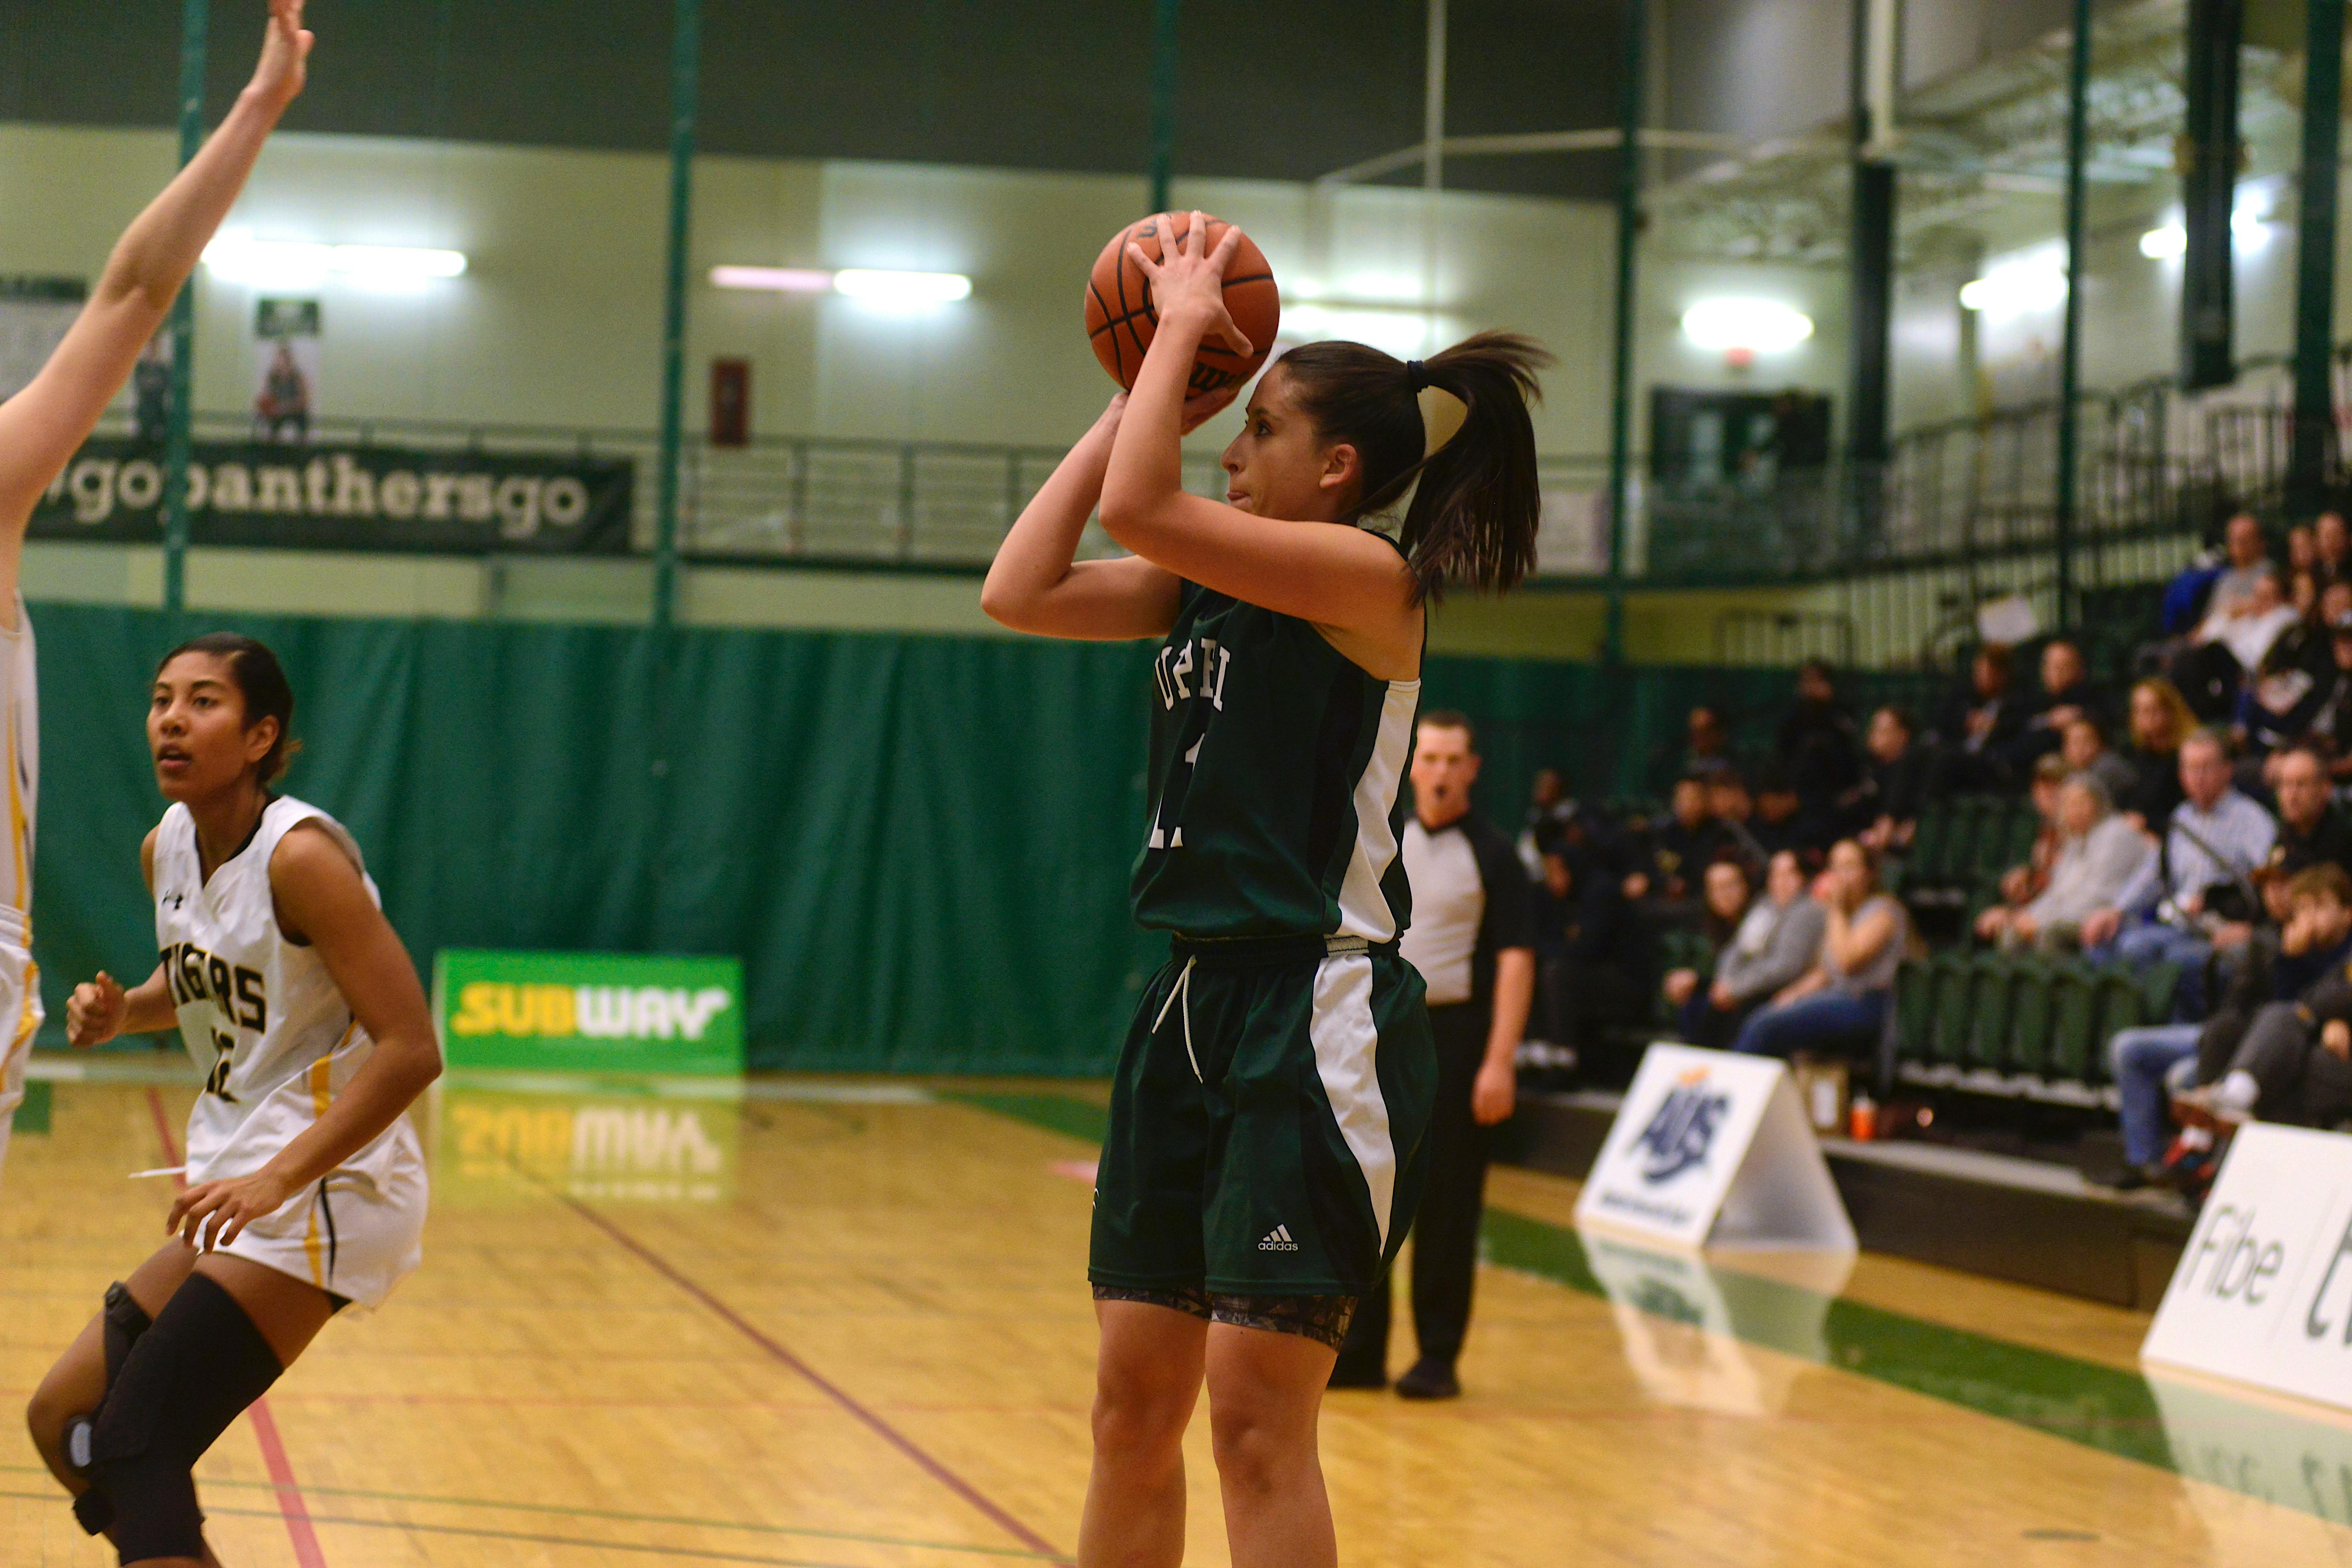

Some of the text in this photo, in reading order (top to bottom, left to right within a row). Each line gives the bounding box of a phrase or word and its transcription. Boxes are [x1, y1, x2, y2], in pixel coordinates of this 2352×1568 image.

[452, 981, 730, 1040] SUBWAY
[1258, 1241, 1298, 1251] adidas
[2181, 1201, 2285, 1306] Fibe
